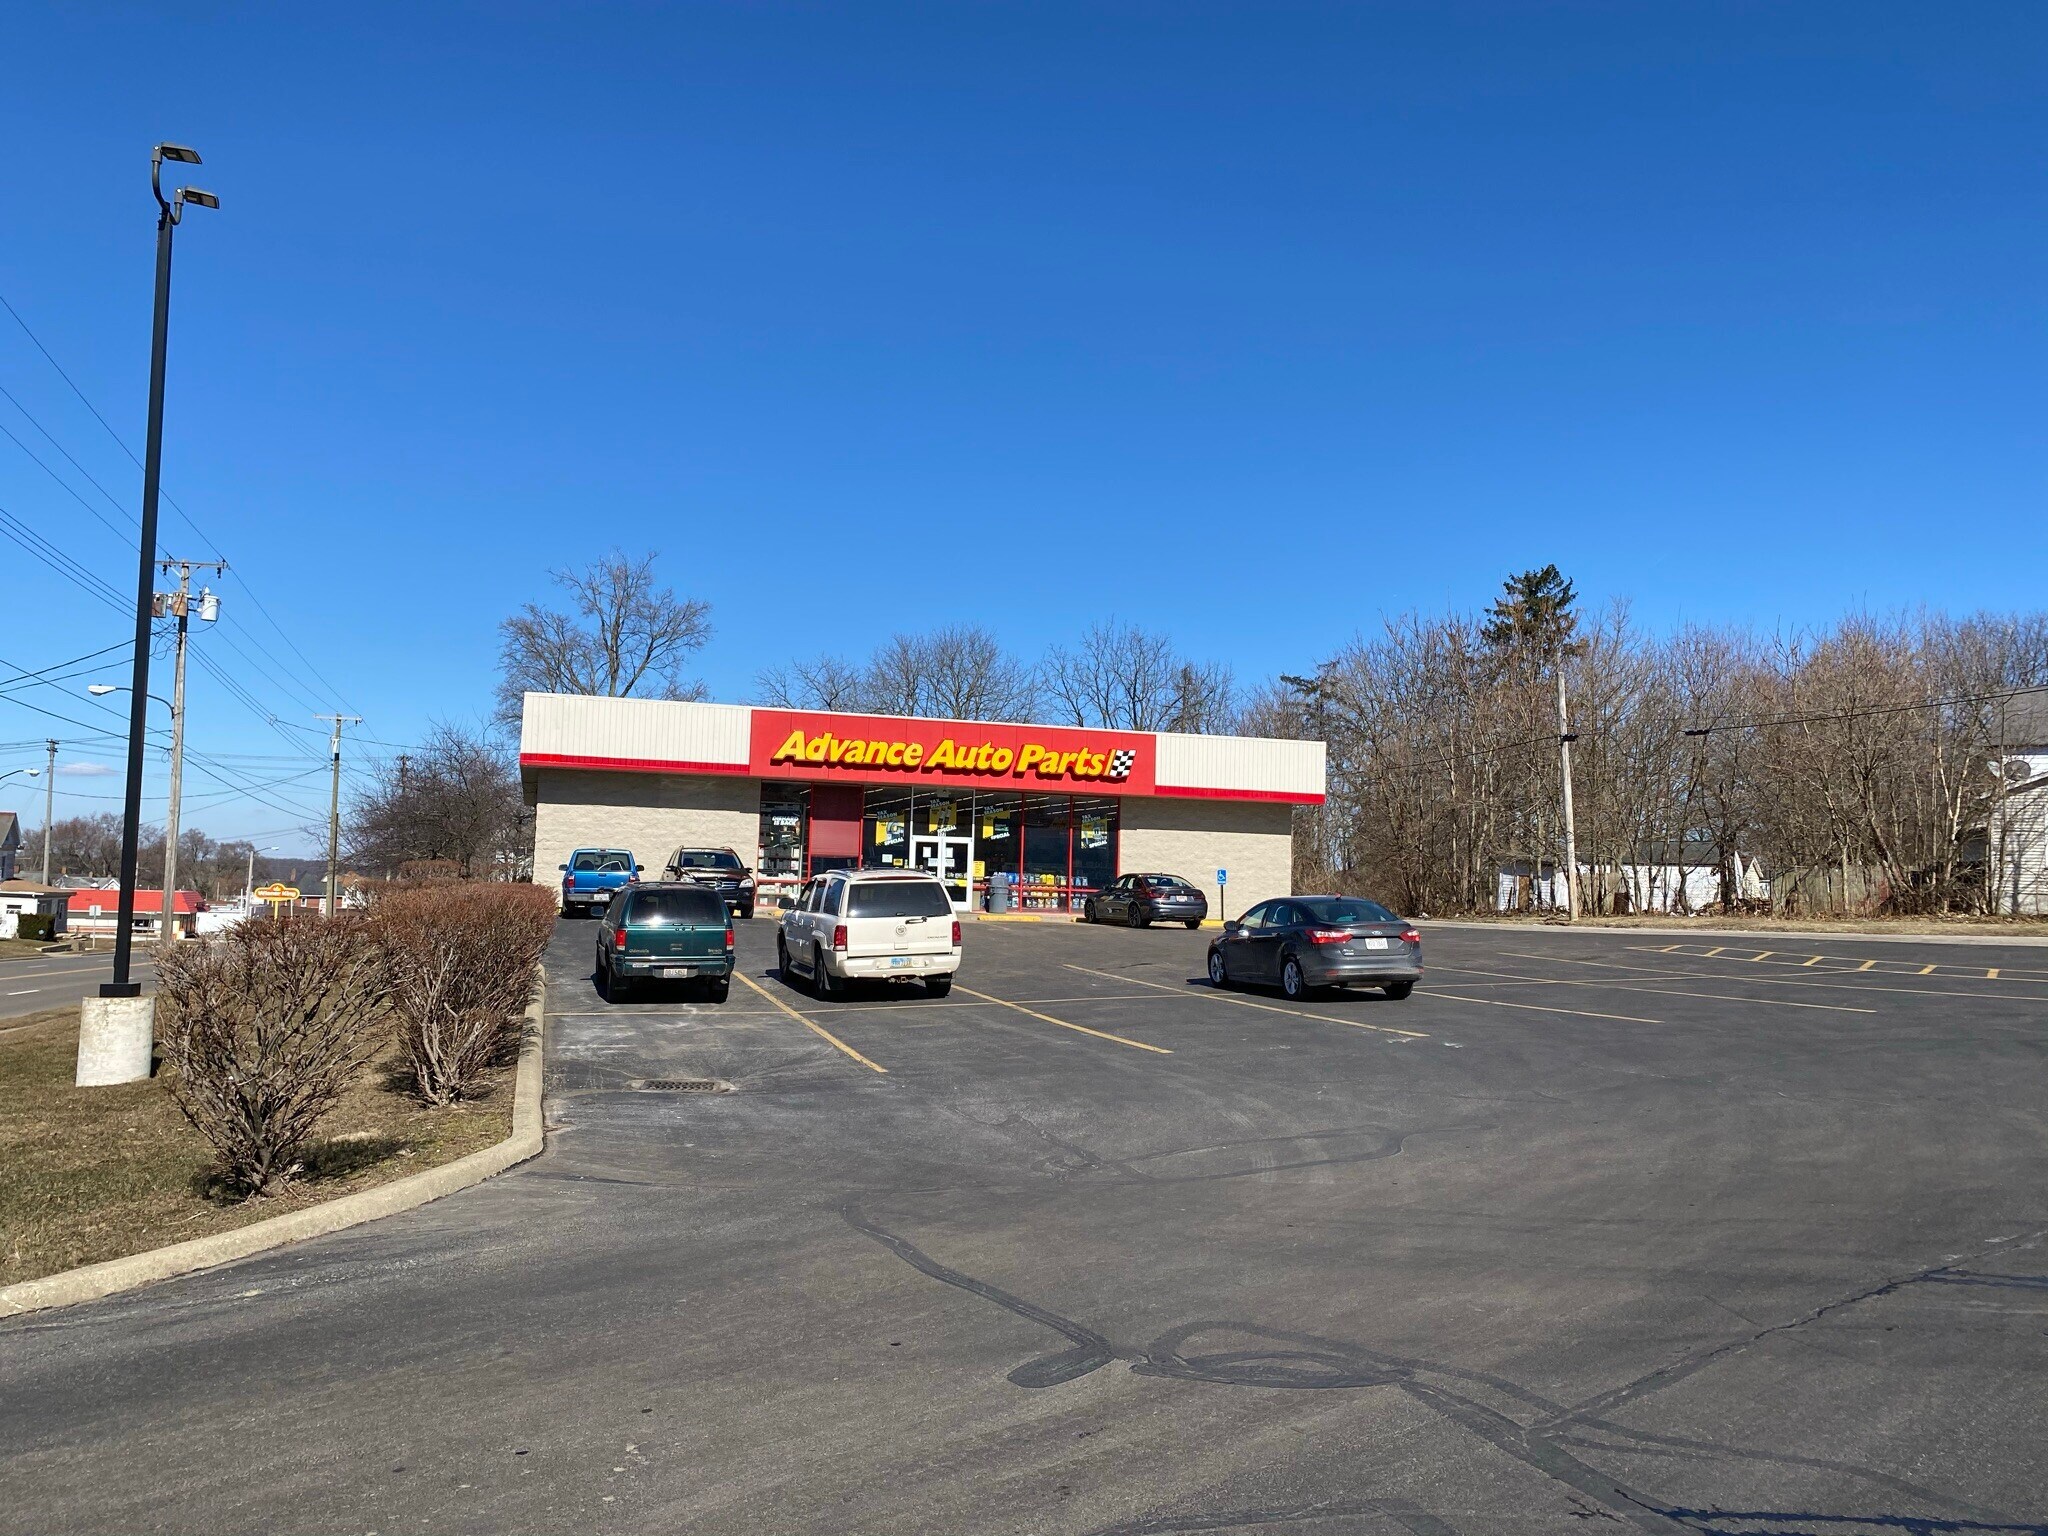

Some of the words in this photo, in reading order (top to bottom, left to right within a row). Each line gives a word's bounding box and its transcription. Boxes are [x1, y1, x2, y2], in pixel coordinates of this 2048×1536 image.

[774, 729, 923, 767] Advance
[927, 738, 1014, 771] Auto
[1016, 743, 1107, 776] Parts
